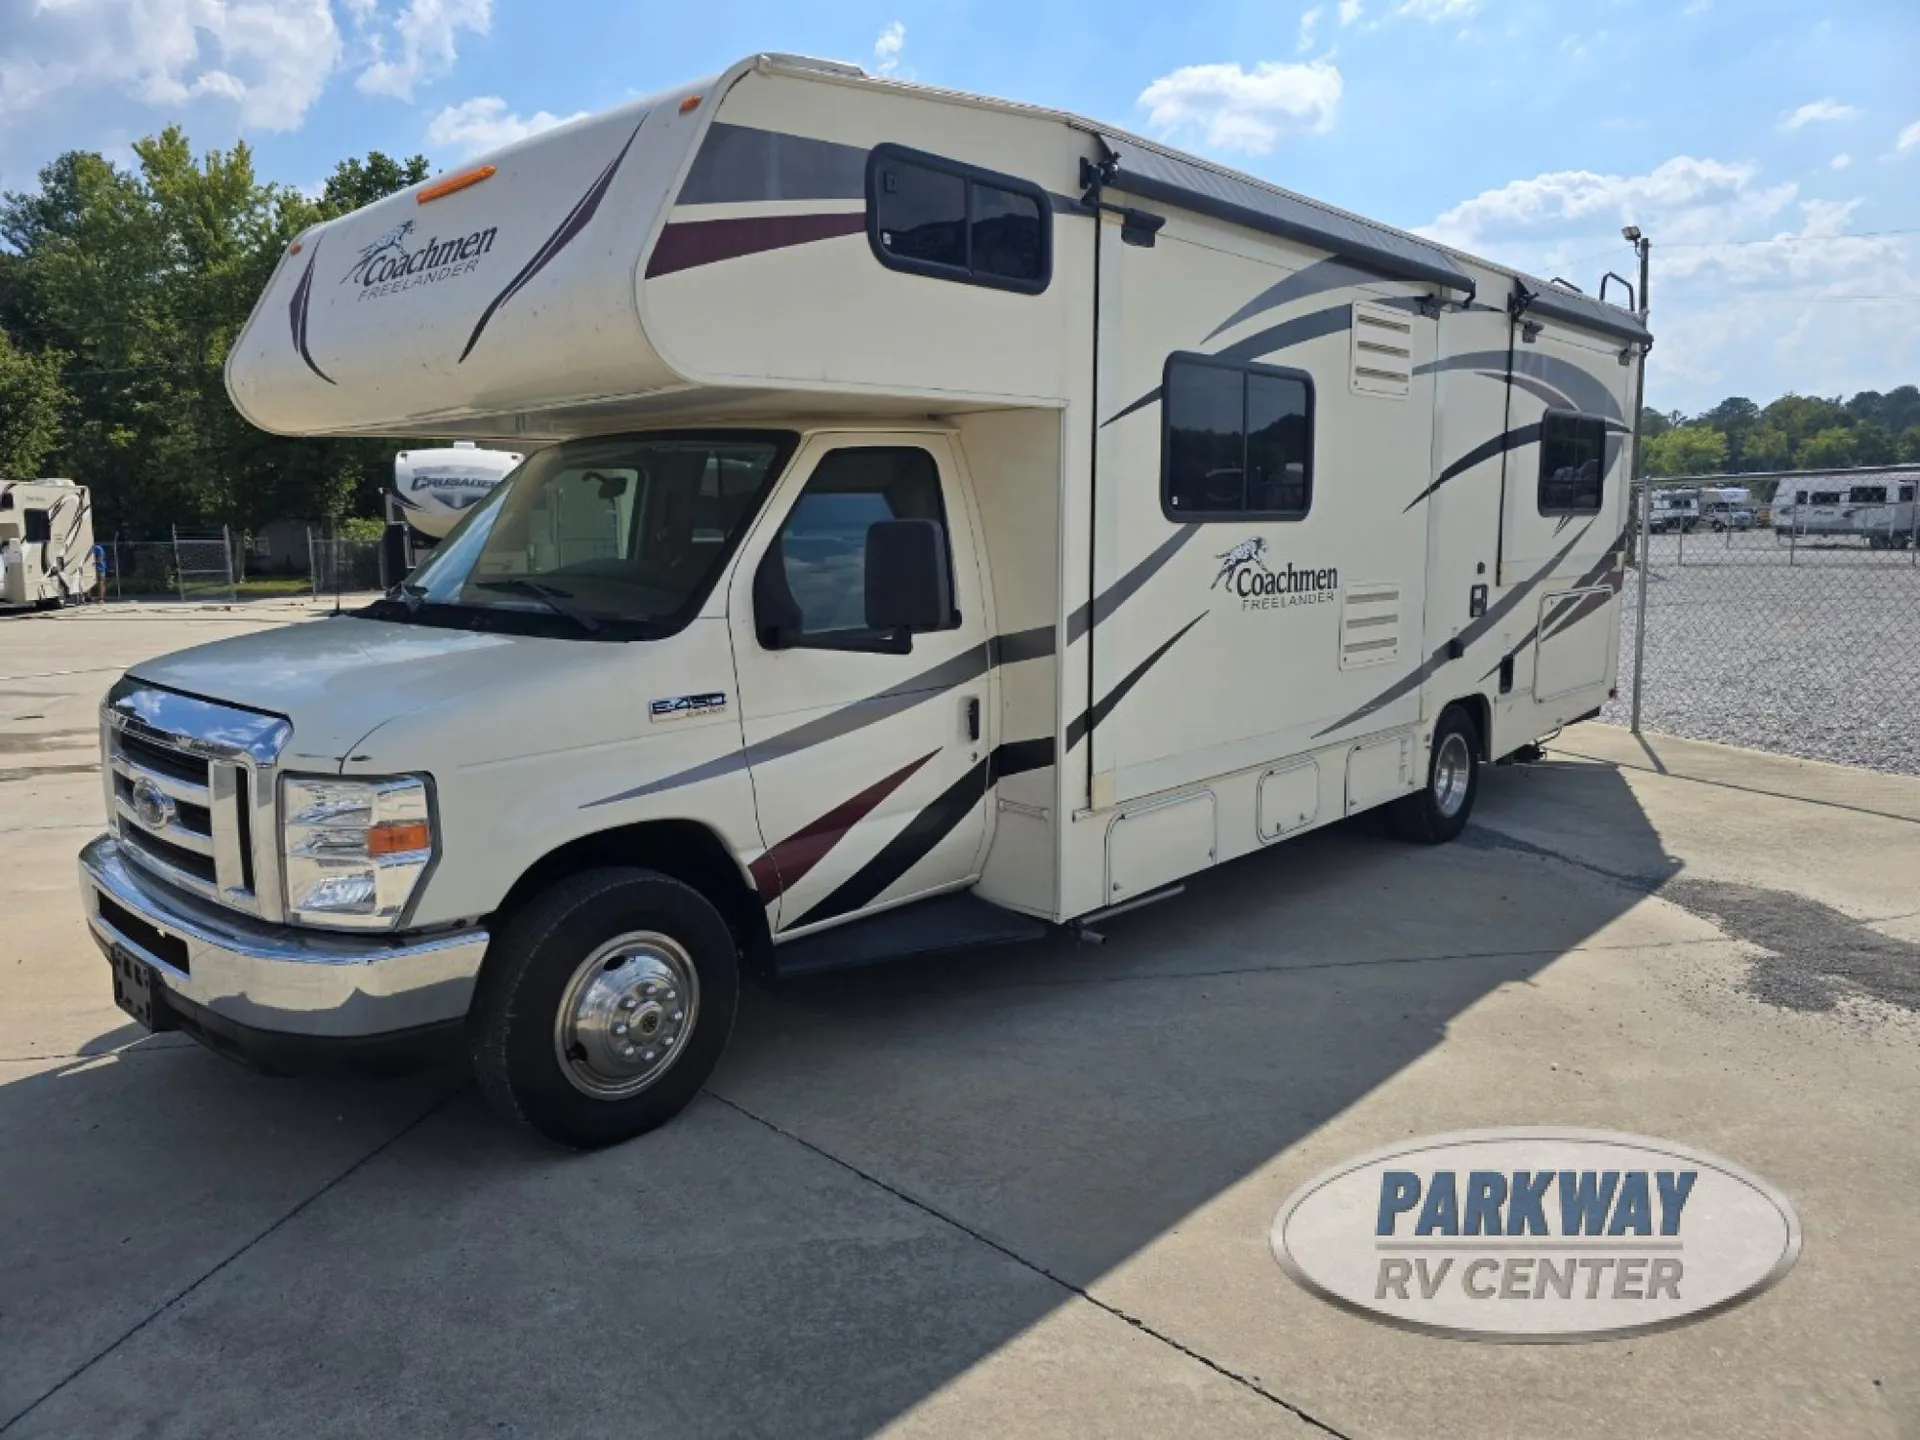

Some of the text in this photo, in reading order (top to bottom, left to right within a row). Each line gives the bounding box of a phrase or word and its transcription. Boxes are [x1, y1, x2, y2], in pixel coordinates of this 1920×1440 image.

[363, 226, 498, 287] Coachmen
[358, 260, 479, 302] FREELANDER
[1237, 562, 1338, 597] Coachmen
[1242, 592, 1335, 611] FREELANDER
